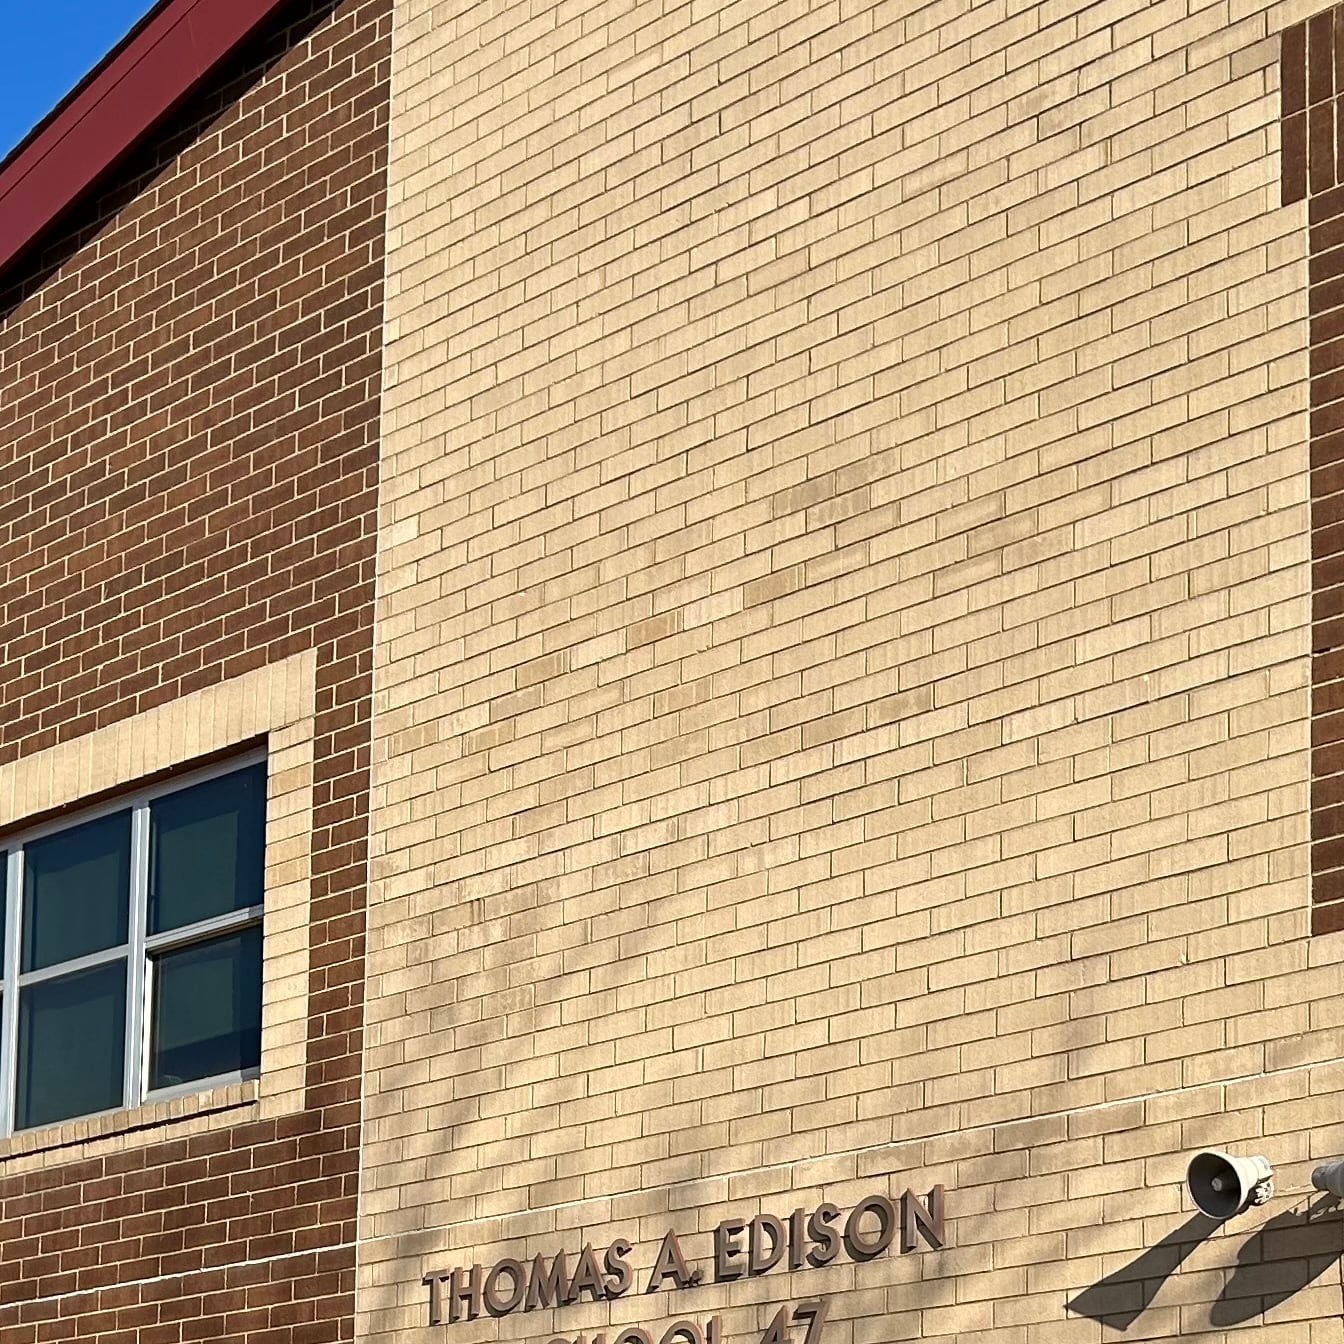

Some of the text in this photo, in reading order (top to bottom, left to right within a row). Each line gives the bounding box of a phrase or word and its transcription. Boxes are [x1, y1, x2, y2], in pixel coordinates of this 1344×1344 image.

[422, 1184, 946, 1325] THOMAS A. EDISON
